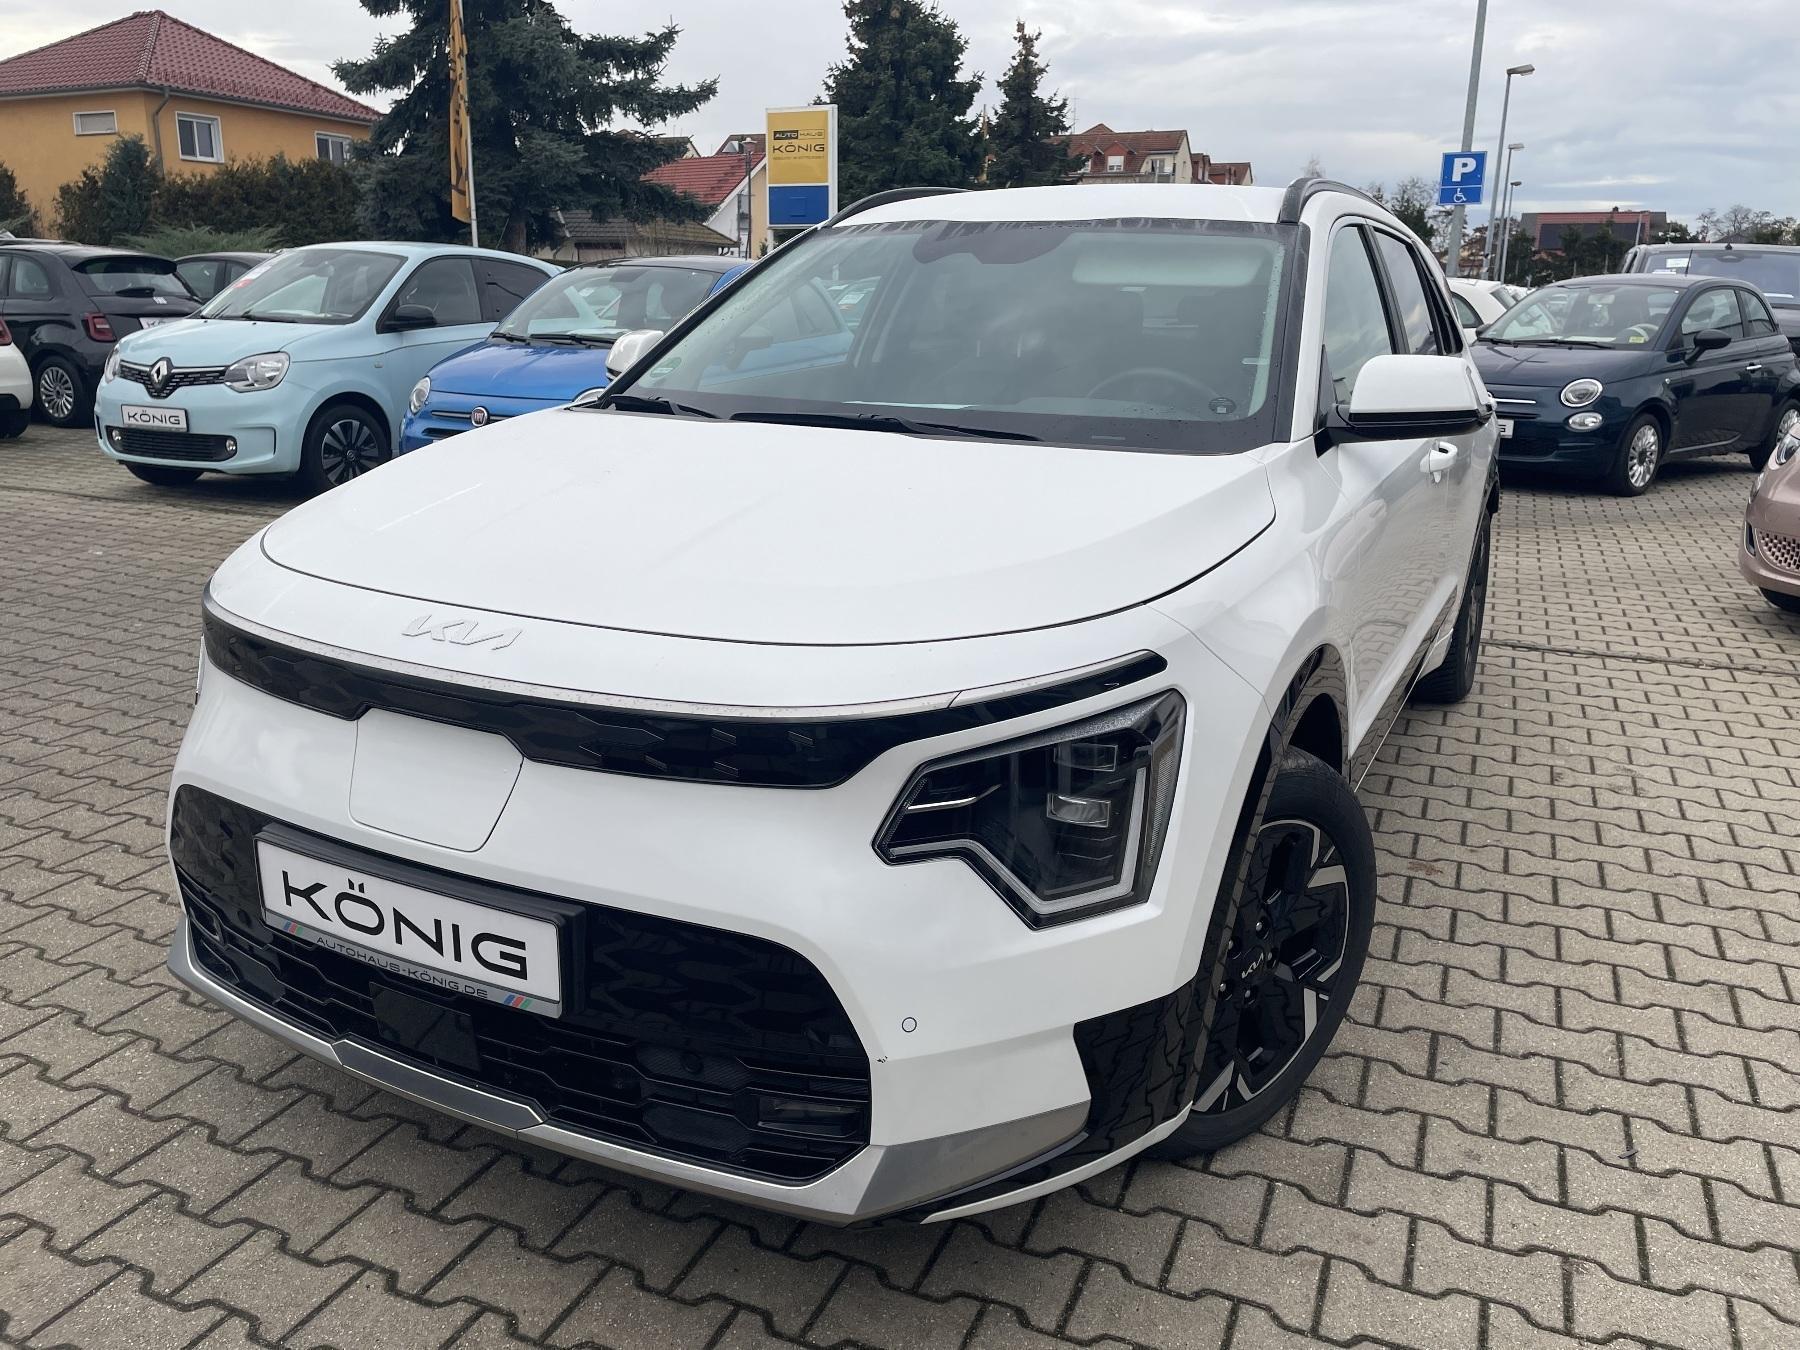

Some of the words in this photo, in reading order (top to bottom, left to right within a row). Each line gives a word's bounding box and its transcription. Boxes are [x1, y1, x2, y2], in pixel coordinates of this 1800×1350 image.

[773, 141, 825, 153] KÖNIG
[1452, 157, 1477, 182] P
[127, 409, 181, 425] KÖNIG
[281, 869, 528, 981] KÖNIG
[316, 935, 489, 1000] AUTOHAUS-KÖNIG.DE
